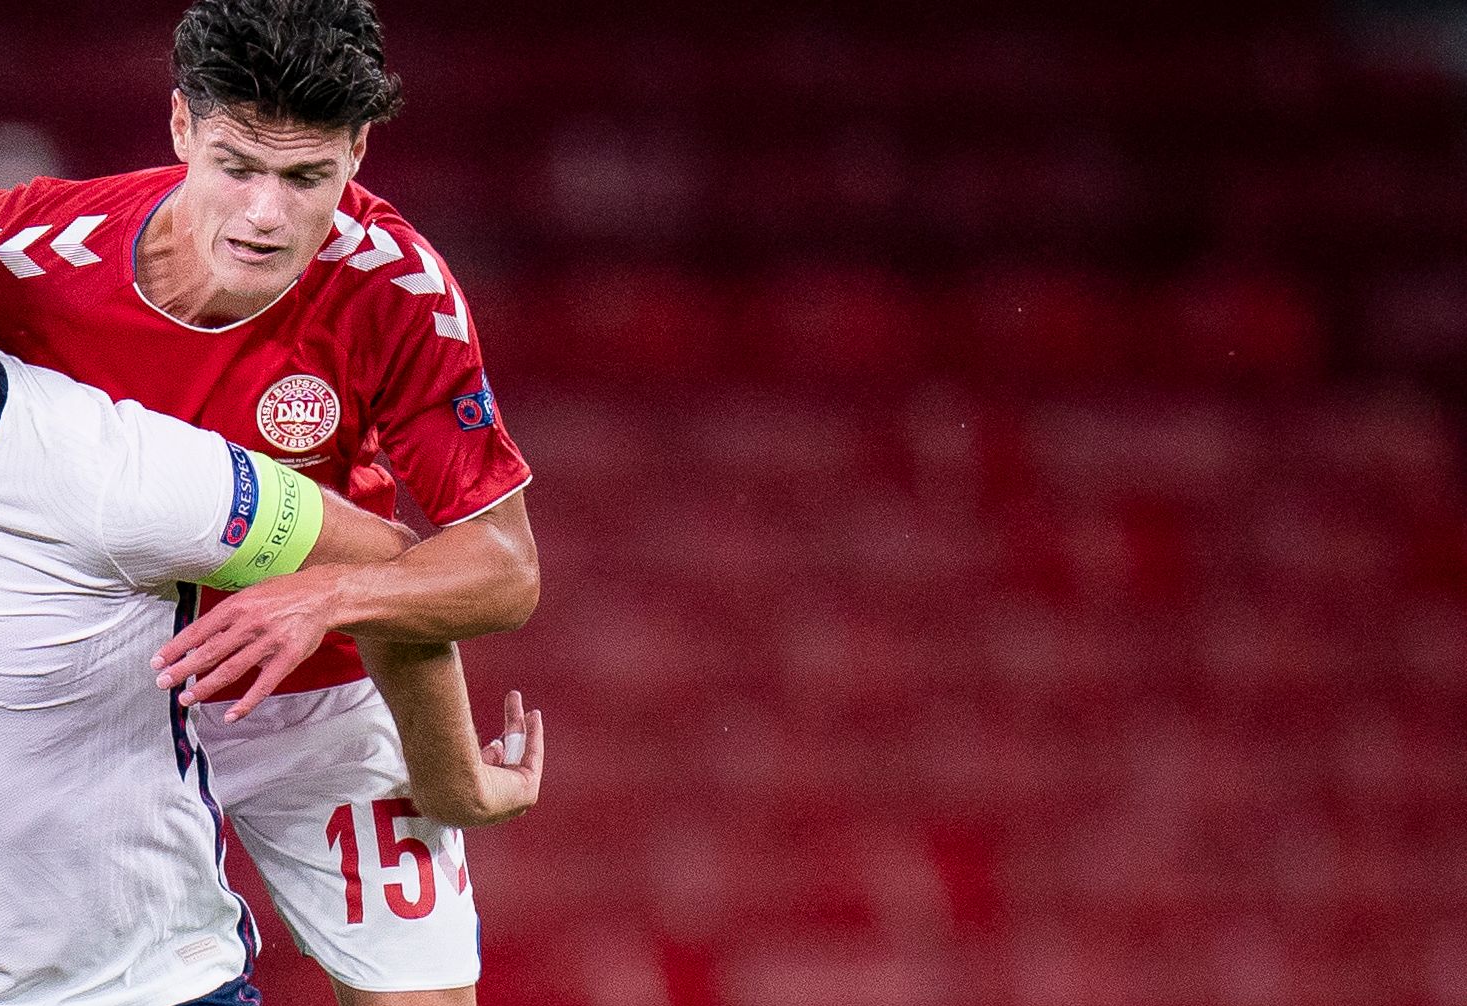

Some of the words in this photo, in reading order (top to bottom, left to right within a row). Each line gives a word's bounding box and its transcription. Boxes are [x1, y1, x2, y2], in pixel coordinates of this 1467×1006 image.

[261, 397, 281, 440] DANSK
[316, 398, 336, 438] UNION
[275, 401, 322, 423] DBU
[283, 437, 315, 448] 1889
[231, 443, 253, 516] RESPECT
[271, 467, 297, 546] RESPECT
[325, 797, 436, 925] 15
